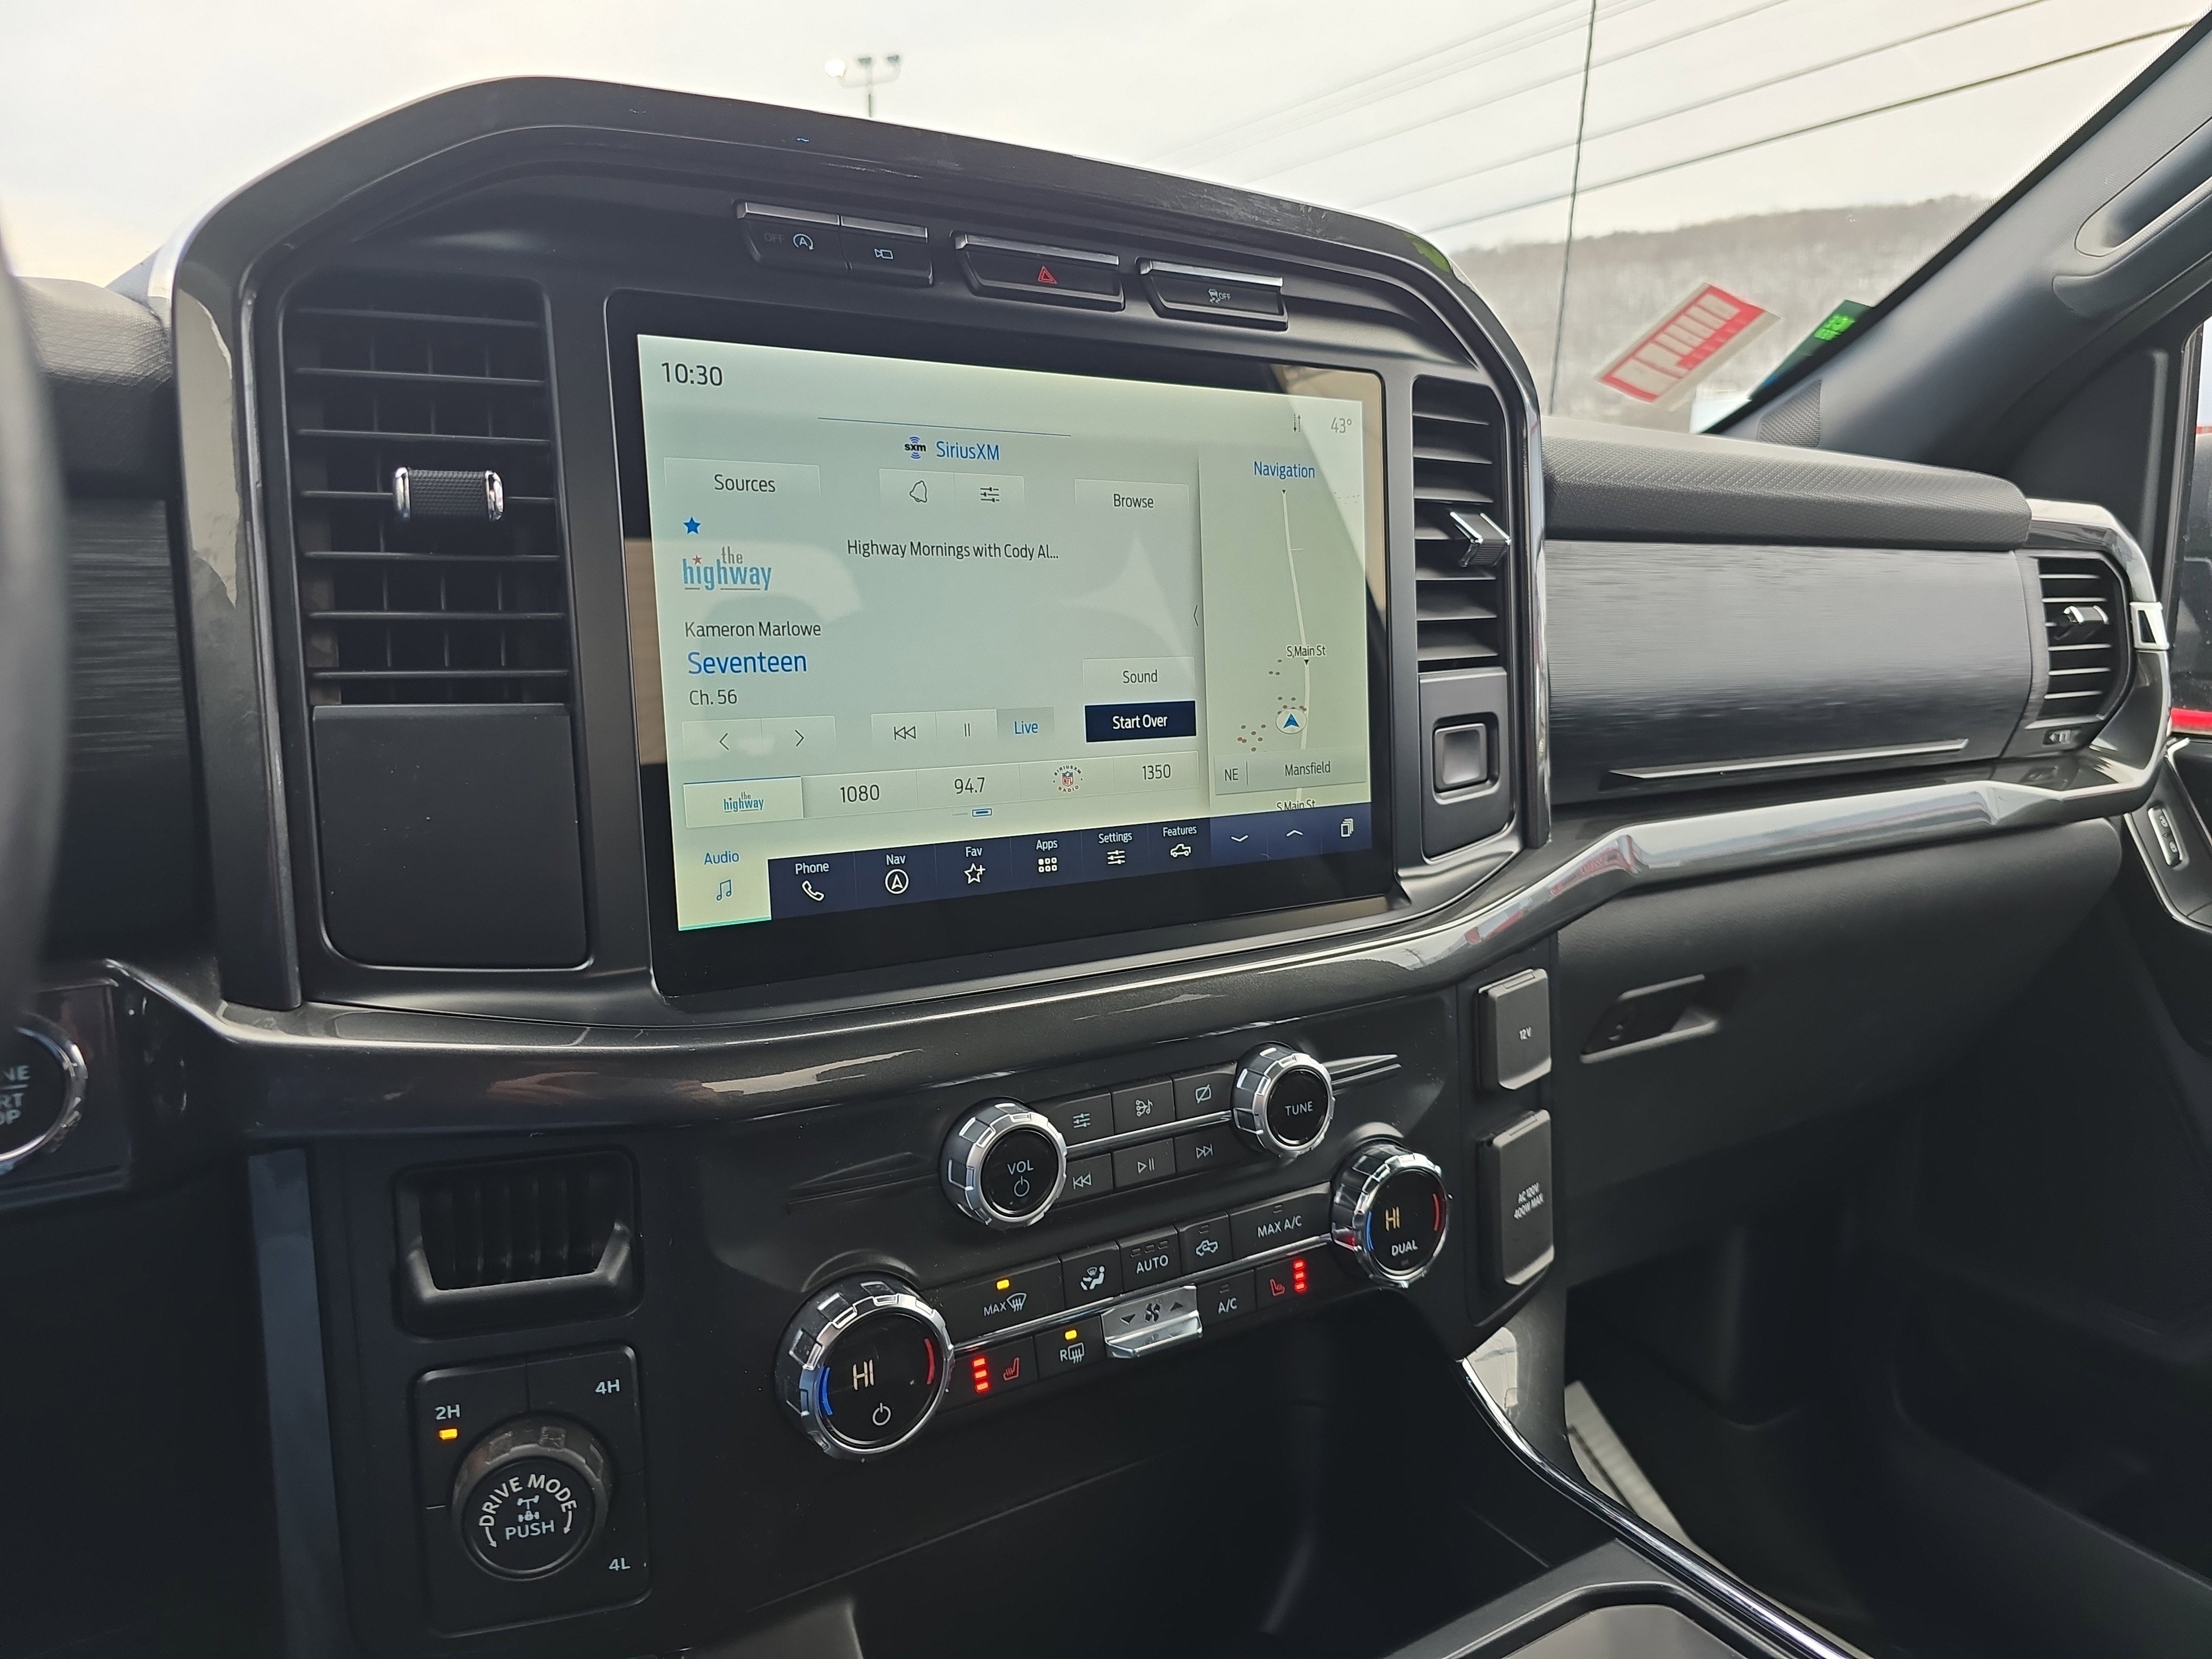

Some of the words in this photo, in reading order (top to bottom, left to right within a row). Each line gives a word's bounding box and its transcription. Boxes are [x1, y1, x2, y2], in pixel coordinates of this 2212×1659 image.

[661, 362, 723, 385] 10:30
[1330, 417, 1352, 433] 43°
[904, 443, 926, 452] sxm
[936, 441, 1000, 460] SiriusXM
[1253, 461, 1315, 480] Navigation
[714, 474, 776, 492] Sources
[1113, 493, 1154, 509] Browse
[721, 545, 743, 564] the
[847, 539, 907, 558] Highway
[909, 541, 970, 559] Mornings
[972, 543, 1001, 558] with
[1004, 544, 1034, 560] Cody
[1037, 544, 1059, 559] Al...
[683, 558, 772, 591] highway
[685, 621, 755, 638] Kameron
[758, 621, 822, 636] Marlowe
[1287, 646, 1293, 657] S
[1294, 645, 1315, 657] Main
[1316, 645, 1326, 657] St
[687, 652, 807, 675] Seventeen
[1122, 669, 1158, 684] Sound
[689, 690, 715, 706] Ch.
[717, 689, 738, 705] 56
[1014, 720, 1039, 735] Live
[1113, 715, 1141, 730] Start
[1143, 714, 1168, 729] Over
[1054, 765, 1082, 776] SIRIUSXM
[1142, 764, 1171, 780] 1350
[1224, 768, 1239, 782] NE
[1284, 761, 1331, 776] Mansfield
[840, 784, 880, 803] 1080
[954, 777, 986, 795] 94.7
[741, 791, 751, 800] the
[724, 798, 764, 812] highway
[1284, 800, 1304, 811] Main
[1306, 799, 1316, 808] St
[1098, 831, 1133, 845] Settings
[1162, 824, 1197, 838] Features
[965, 846, 983, 858] Fav
[1036, 838, 1058, 852] Apps
[704, 851, 740, 865] Audio
[885, 854, 906, 866] Nav
[795, 861, 829, 874] Phone
[1519, 1027, 1531, 1040] 12V
[1284, 1101, 1314, 1117] TUNE
[1007, 1160, 1034, 1175] VOL
[1531, 1193, 1544, 1208] MAX
[1257, 1220, 1283, 1238] MAX
[1283, 1214, 1302, 1231] A/C
[1385, 1207, 1400, 1231] HI
[1391, 1239, 1418, 1257] DUAL
[1136, 1255, 1169, 1274] AUTO
[983, 1302, 1007, 1317] MAX
[1218, 1297, 1237, 1314] A/C
[1060, 1349, 1069, 1362] R
[852, 1359, 875, 1391] HI
[595, 1379, 620, 1394] 4H
[435, 1404, 461, 1420] 2H
[479, 1477, 523, 1527] DRIVE
[527, 1474, 577, 1512] MODE
[505, 1520, 555, 1540] PUSH
[608, 1558, 631, 1571] 4L
